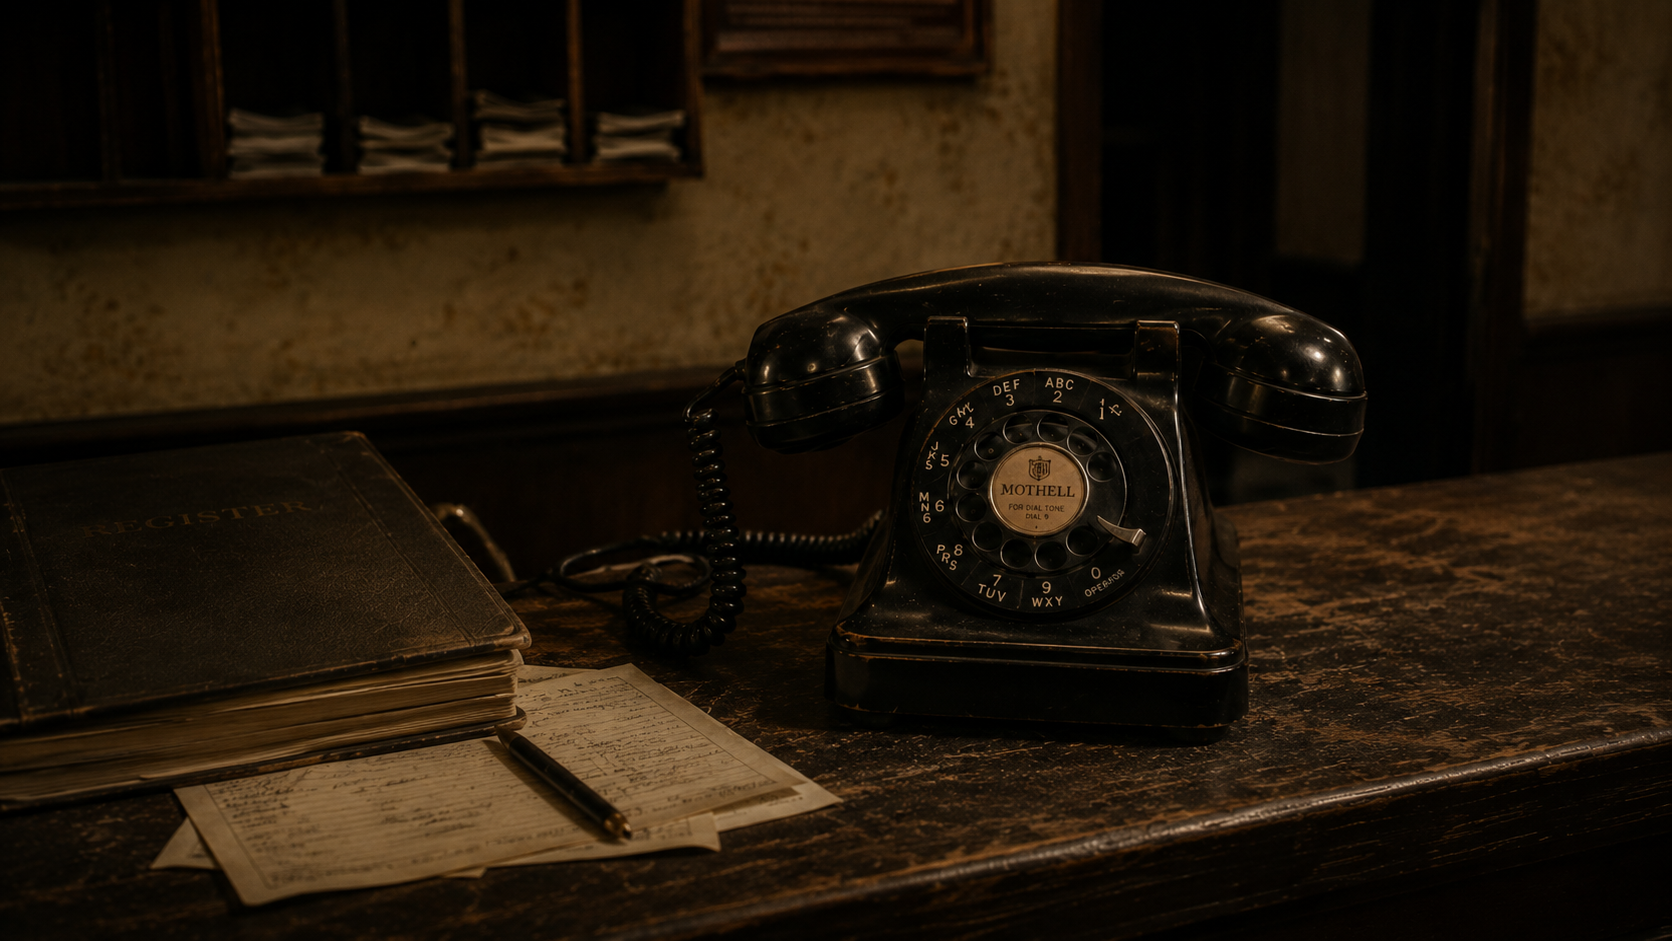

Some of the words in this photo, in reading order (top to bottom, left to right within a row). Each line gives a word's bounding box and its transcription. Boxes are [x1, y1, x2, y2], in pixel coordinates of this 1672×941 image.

[992, 378, 1020, 397] DEF
[1044, 376, 1074, 391] ABC
[1005, 393, 1015, 407] 3
[1052, 390, 1063, 404] 2
[964, 416, 975, 429] 4
[940, 453, 950, 468] 5
[1000, 483, 1075, 498] MOTHELL
[934, 499, 945, 513] 6
[1008, 503, 1024, 511] FOR
[1025, 504, 1043, 512] DIAL
[1045, 504, 1065, 513] TONE
[79, 500, 313, 538] REGISTER
[953, 543, 964, 557] 8
[936, 544, 958, 571] PRS
[1090, 566, 1102, 580] 0
[992, 574, 1003, 587] 7
[1041, 580, 1052, 595] 9
[978, 583, 1007, 603] TUV
[1031, 595, 1063, 608] WXY
